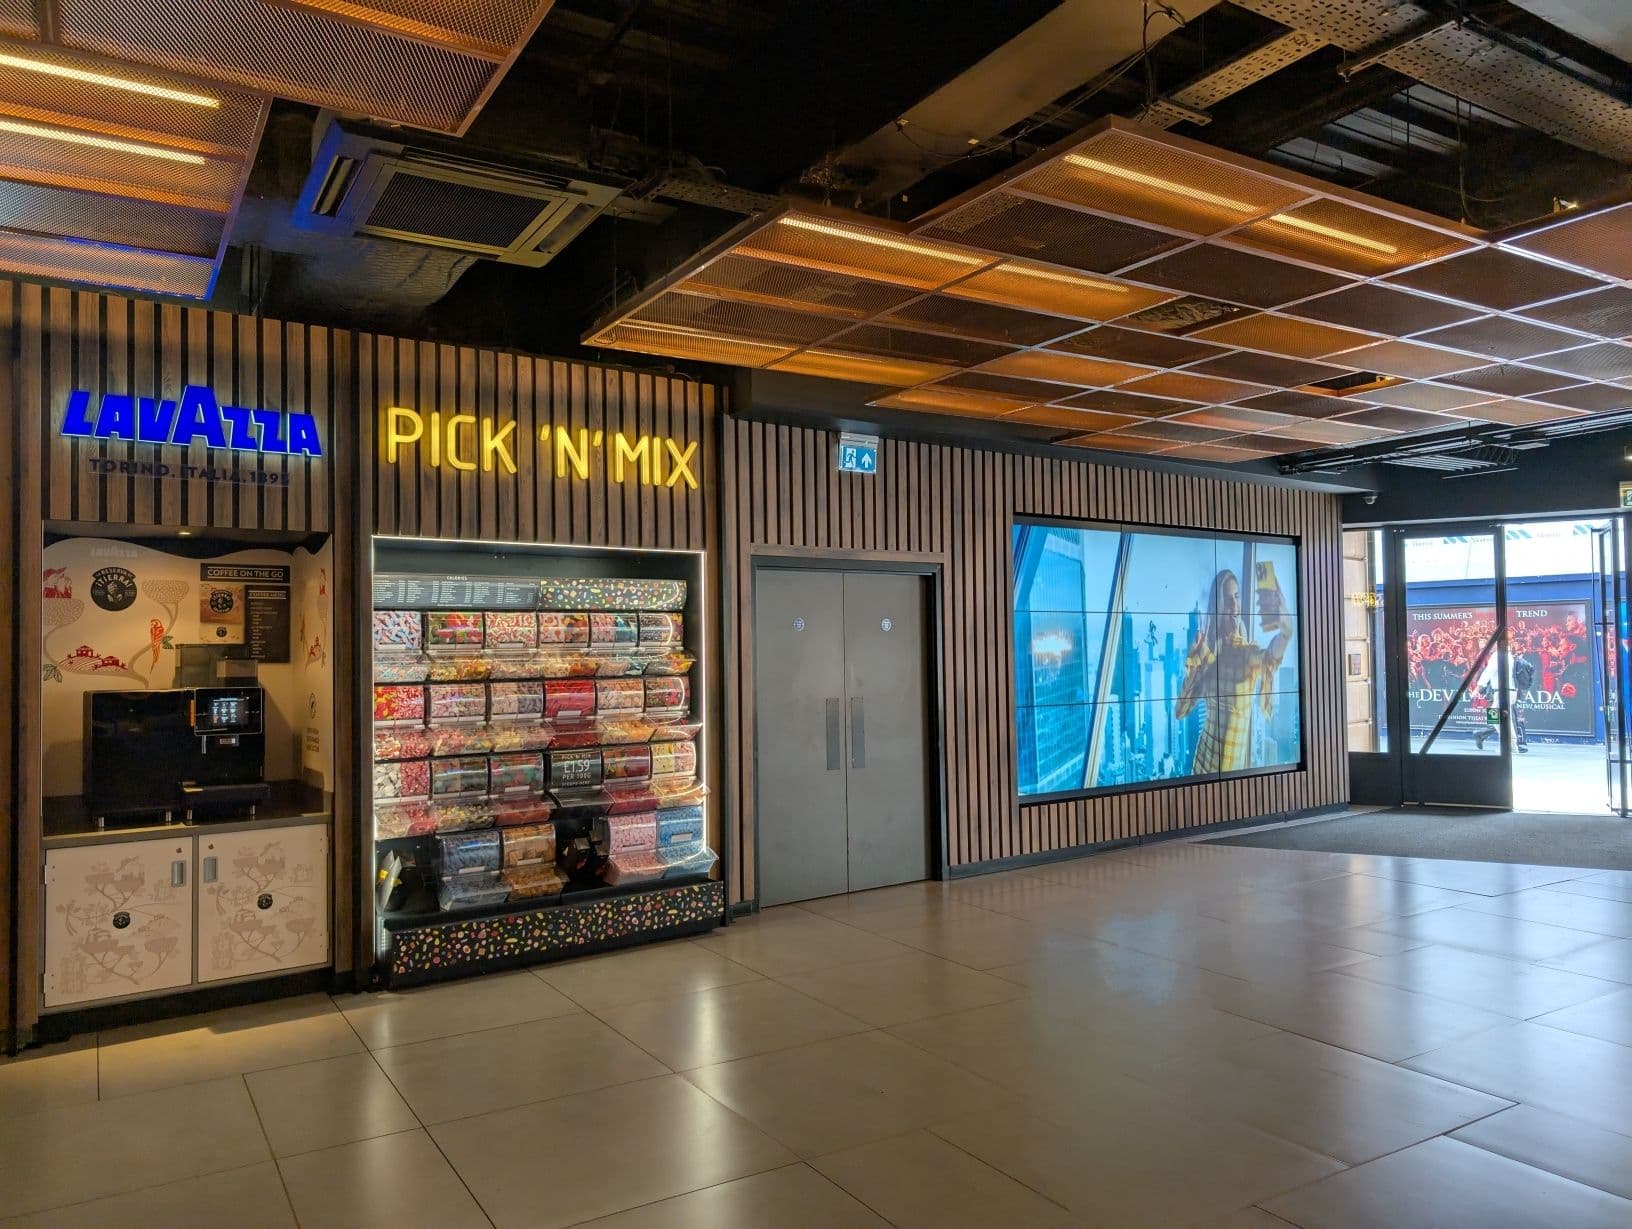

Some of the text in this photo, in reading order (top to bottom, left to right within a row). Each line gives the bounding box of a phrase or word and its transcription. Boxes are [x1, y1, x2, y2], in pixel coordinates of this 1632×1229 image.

[61, 384, 323, 457] LAVAZZA
[386, 406, 518, 474] PICK
[615, 431, 698, 490] MIX
[208, 569, 238, 577] COFFEE
[254, 570, 269, 578] THE
[1412, 613, 1432, 621] THIS
[1515, 609, 1548, 618] TREND
[1418, 688, 1471, 705] DEVL
